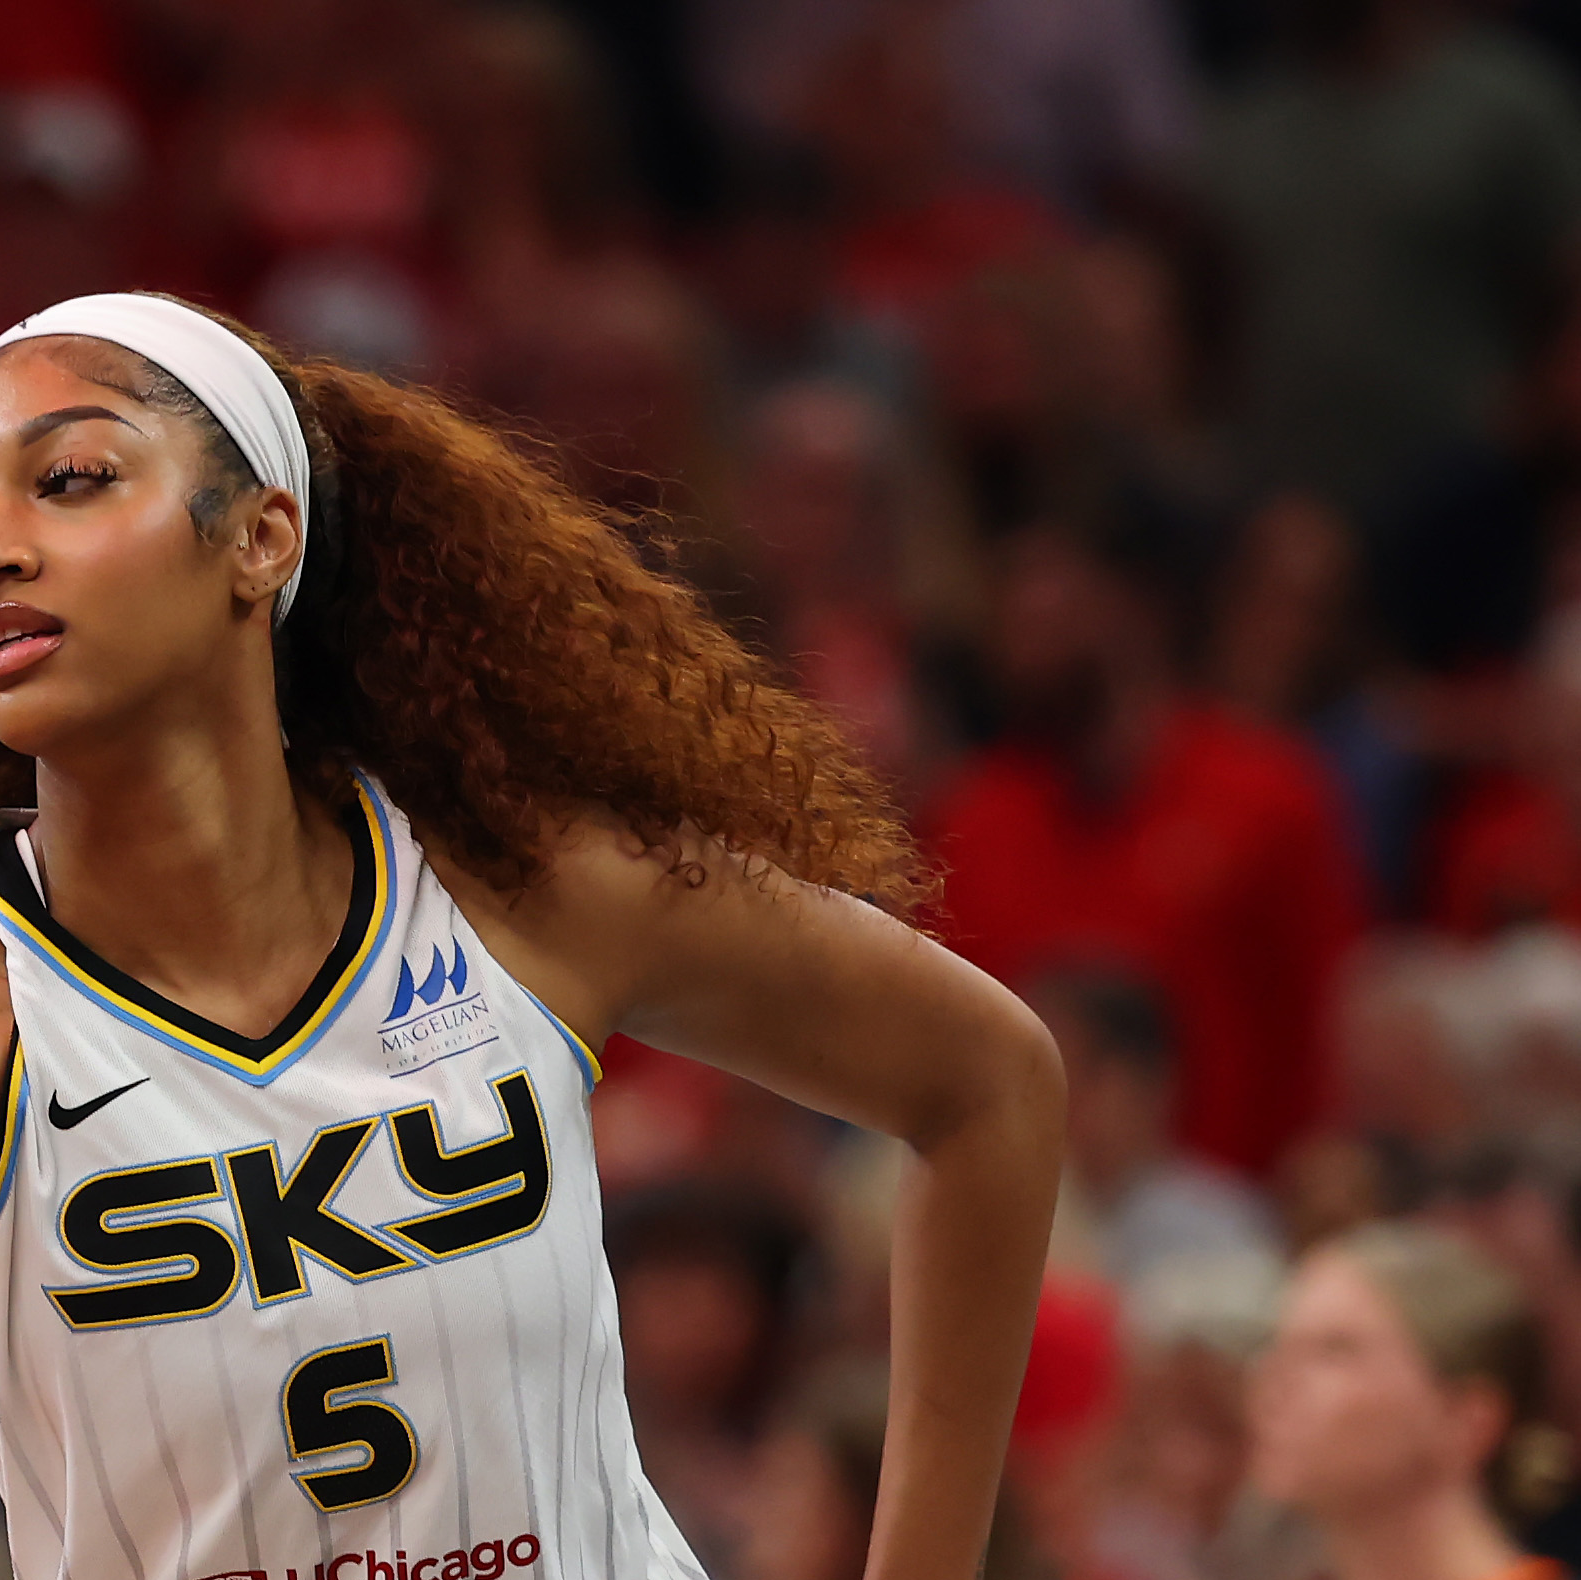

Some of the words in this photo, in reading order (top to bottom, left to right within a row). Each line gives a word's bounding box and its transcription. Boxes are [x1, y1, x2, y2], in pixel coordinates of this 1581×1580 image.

[381, 998, 489, 1054] MAGELLAN
[41, 1066, 553, 1333] SKY
[279, 1333, 420, 1514] 5
